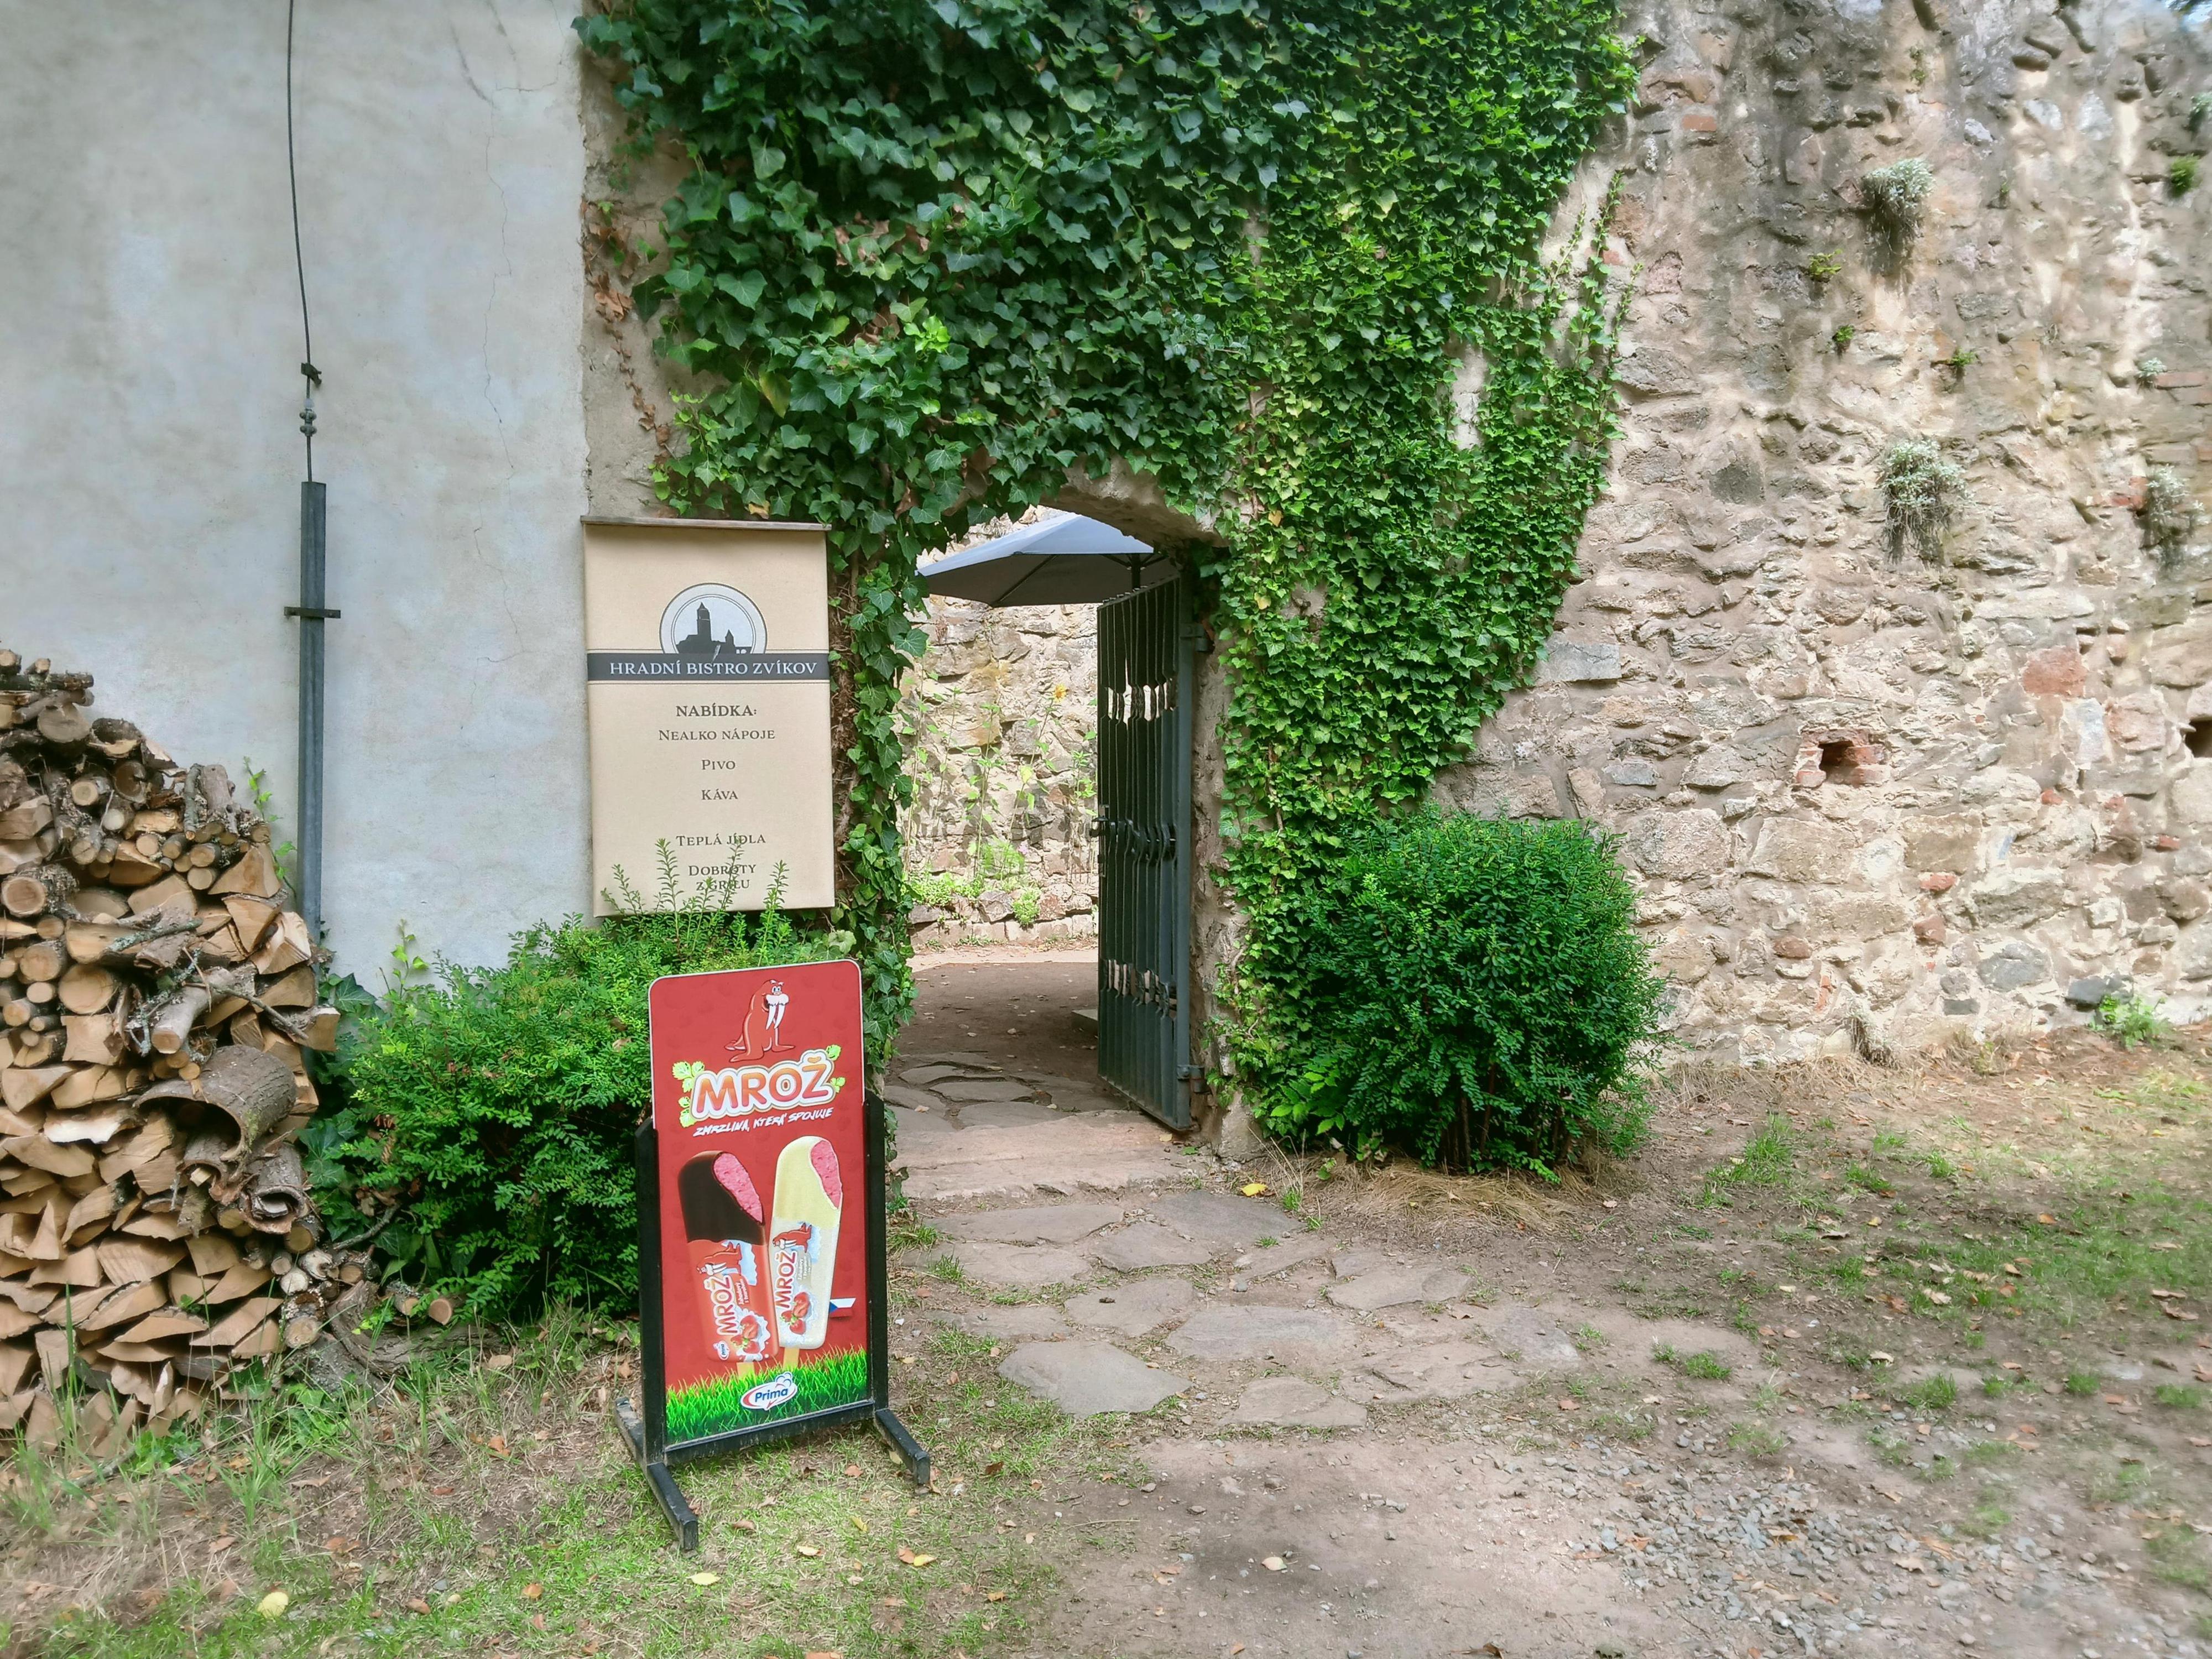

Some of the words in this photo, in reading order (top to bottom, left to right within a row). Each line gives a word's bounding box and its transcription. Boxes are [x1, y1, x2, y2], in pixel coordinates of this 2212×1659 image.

[610, 660, 681, 675] HRADNÍ
[686, 662, 748, 675] BISTRO
[753, 659, 817, 675] ZVÍKOV
[676, 703, 757, 717] NABÍDKA:
[658, 729, 717, 741] NEALKO
[721, 727, 775, 740] NÁPOJE
[701, 759, 736, 770] PIVO
[701, 788, 738, 800] KÁVA
[676, 833, 722, 847] TEPLÁ
[726, 832, 766, 845] JÍDLA
[709, 879, 750, 890] GRLU
[695, 1054, 831, 1115] MROŽ
[753, 1113, 787, 1129] KTERÁ
[787, 1107, 834, 1123] SPOJUJE
[775, 1251, 796, 1309] MROŽ
[706, 1276, 738, 1335] MROŽ
[754, 1387, 789, 1403] Prima
